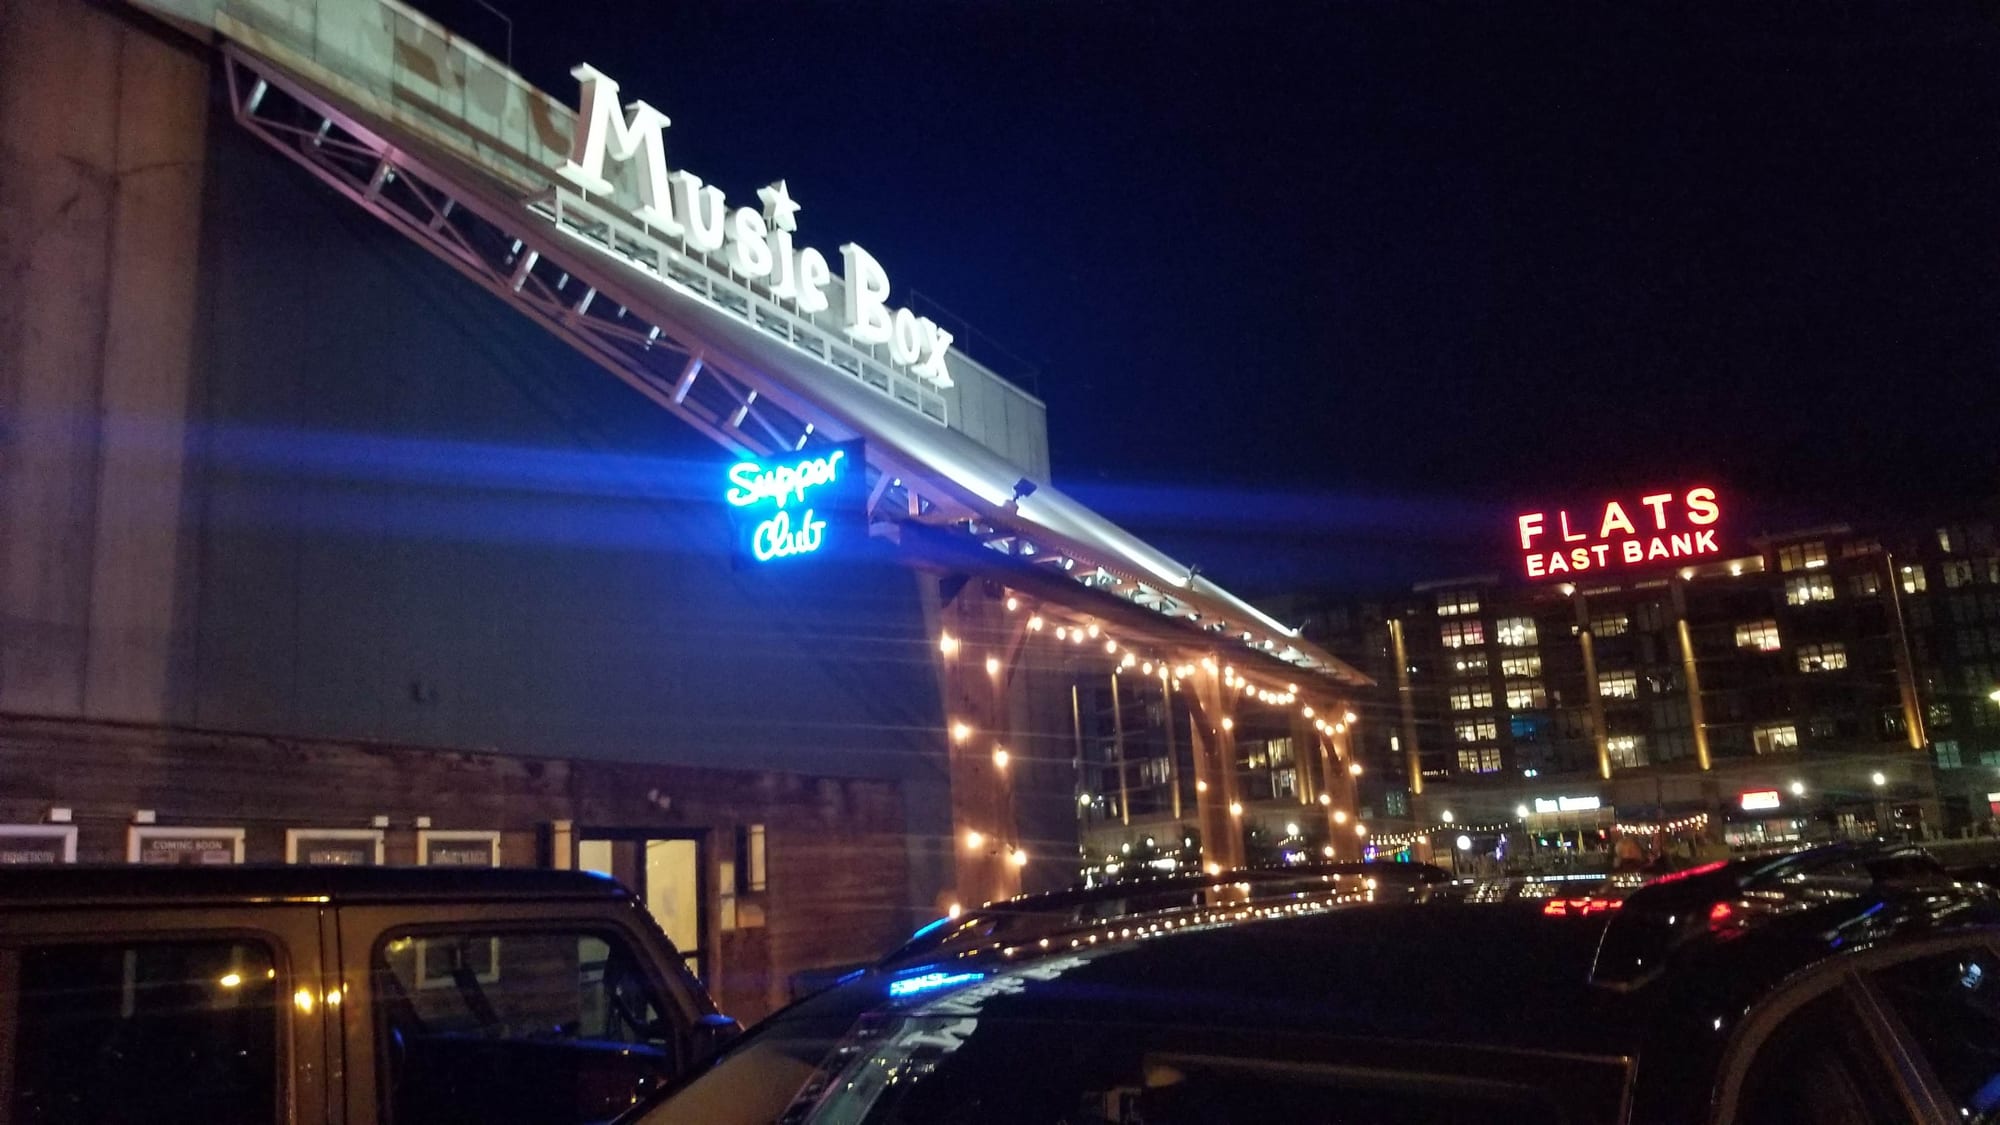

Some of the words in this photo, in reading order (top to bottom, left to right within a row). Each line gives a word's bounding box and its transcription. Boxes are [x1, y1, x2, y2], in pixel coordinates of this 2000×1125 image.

[556, 62, 830, 313] Music
[839, 242, 954, 388] Box
[726, 450, 845, 508] Supper
[753, 508, 827, 562] Club
[1518, 487, 1720, 550] FLATS
[1525, 547, 1609, 577] EAST
[1622, 529, 1719, 564] BANK
[152, 840, 193, 851] COMING
[196, 840, 223, 850] SOON
